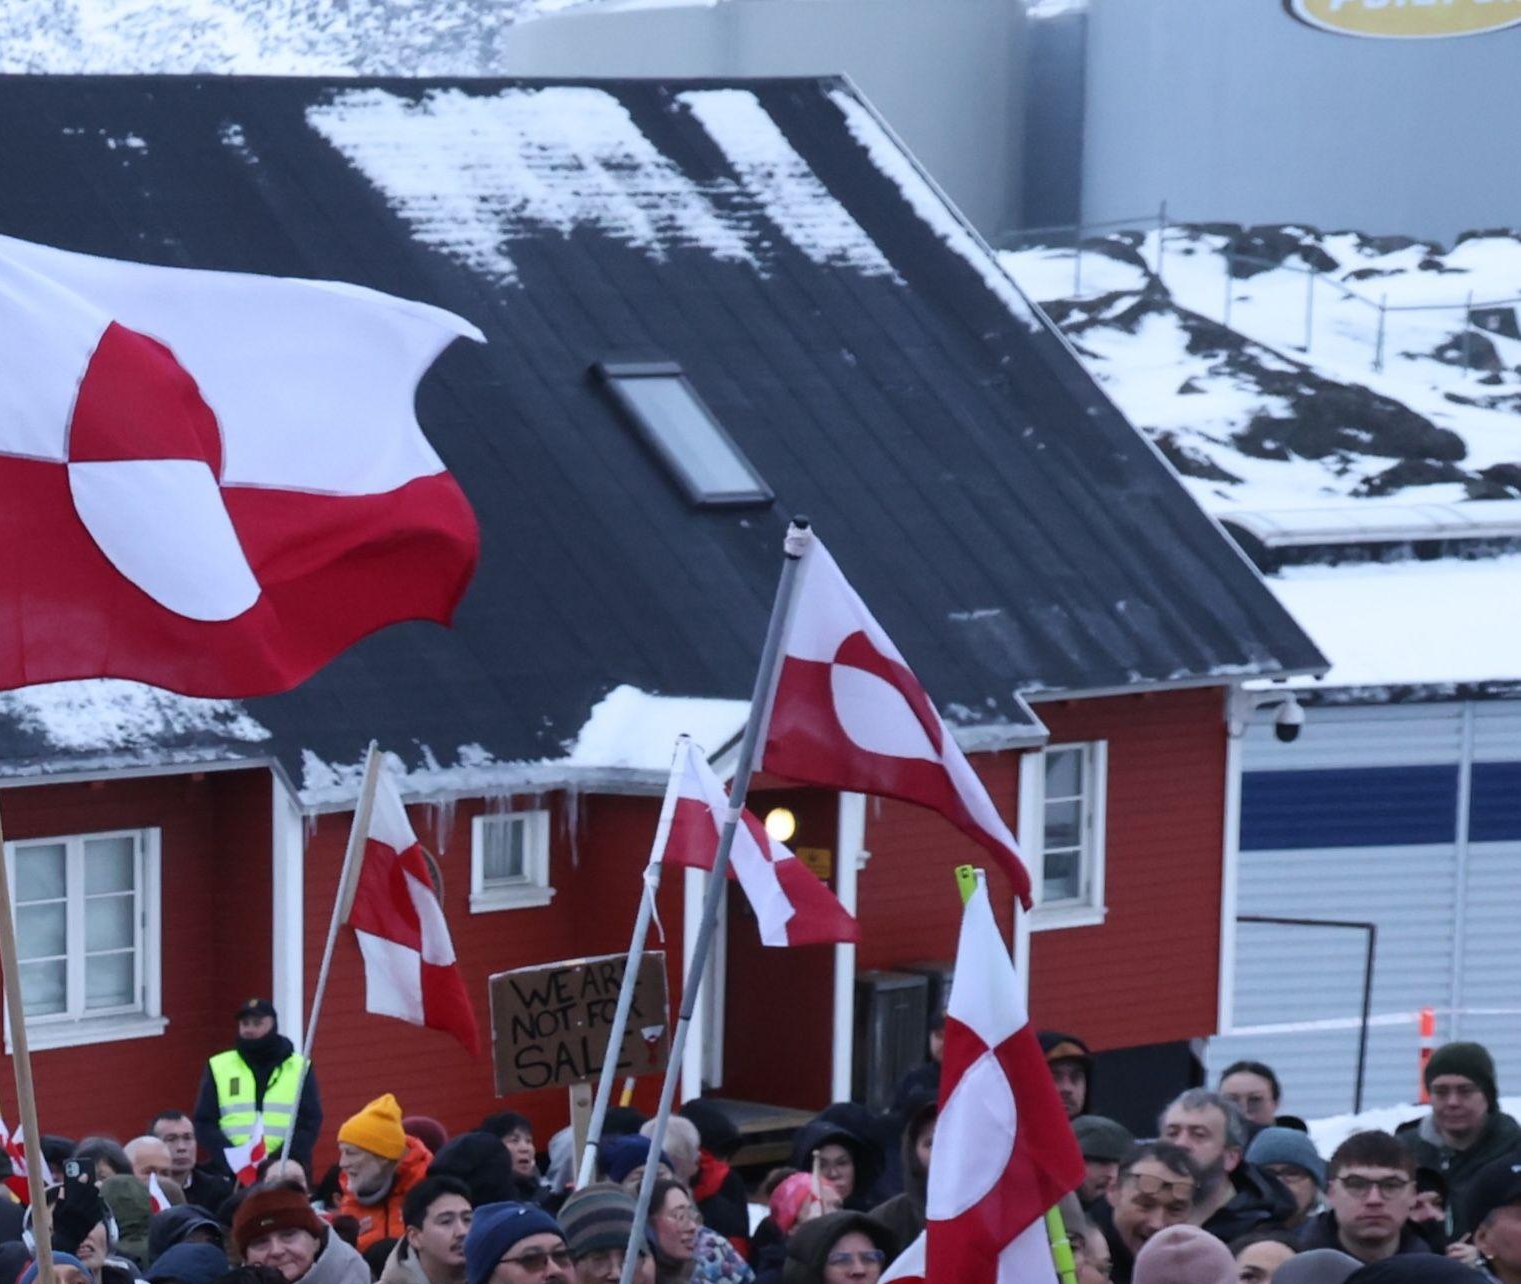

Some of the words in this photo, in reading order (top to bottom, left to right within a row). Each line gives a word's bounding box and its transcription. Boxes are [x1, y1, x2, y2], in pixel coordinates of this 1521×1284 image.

[509, 967, 576, 1010] WE
[581, 958, 642, 999] AR
[511, 1001, 579, 1046] NOT
